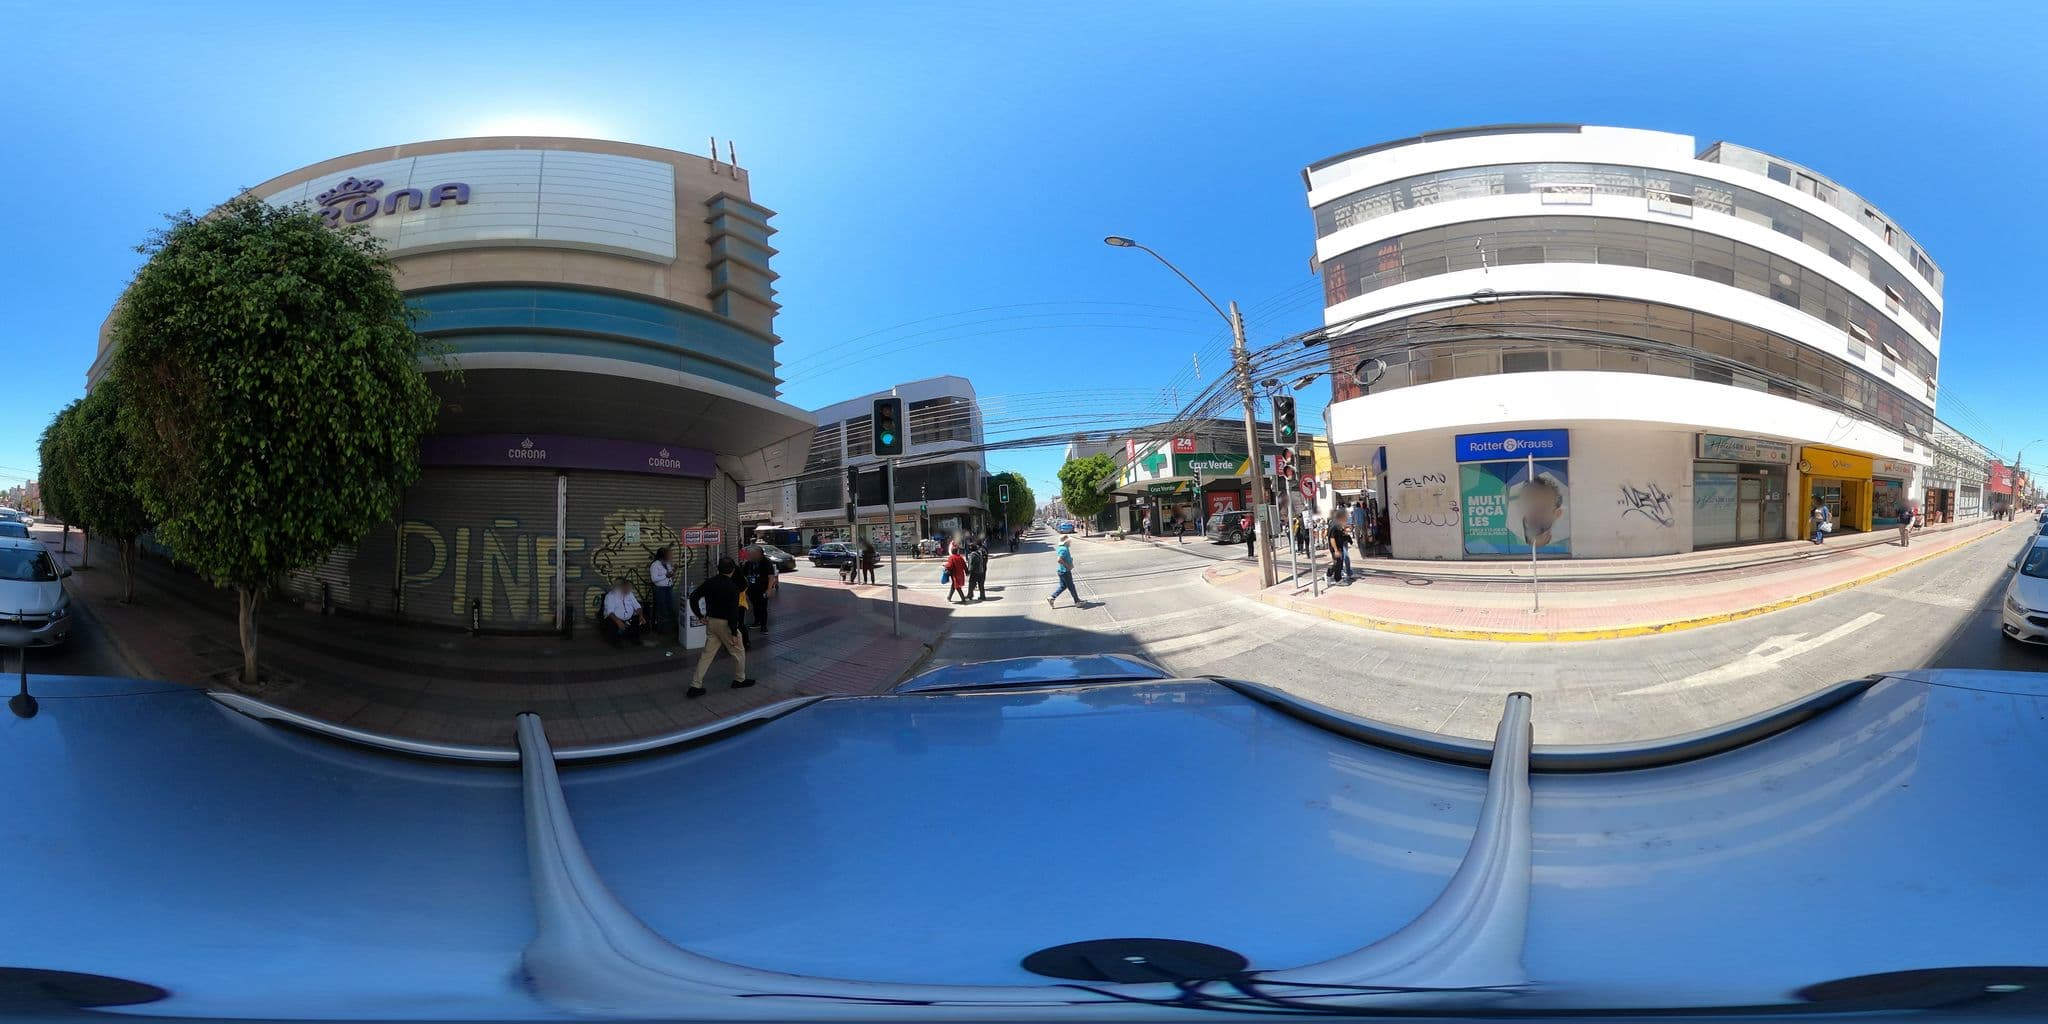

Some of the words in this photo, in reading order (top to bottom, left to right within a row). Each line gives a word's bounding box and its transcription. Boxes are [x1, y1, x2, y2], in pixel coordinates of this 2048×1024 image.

[1178, 438, 1192, 447] 24
[1470, 441, 1504, 452] Rotter
[1517, 439, 1554, 449] Krauss
[508, 449, 546, 459] CORONA
[649, 457, 681, 469] CORONA
[1189, 460, 1208, 470] Cruz
[1208, 460, 1233, 470] Verde
[1468, 494, 1505, 506] MULTI
[1468, 505, 1504, 516] FOCA
[1469, 516, 1489, 527] LES
